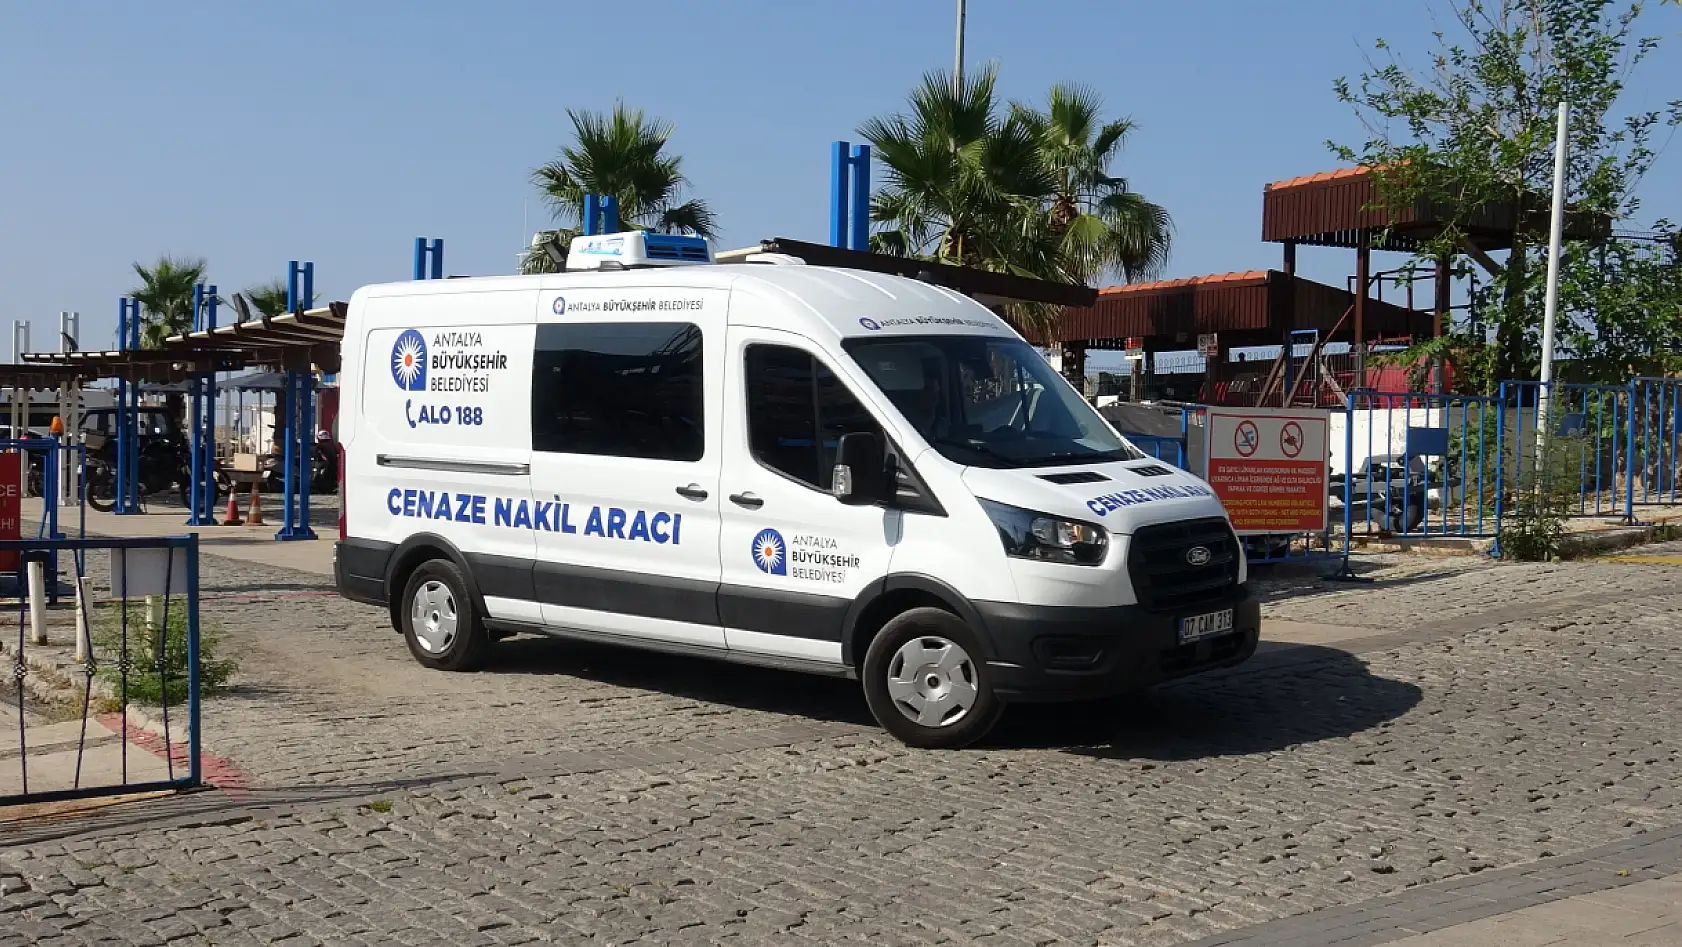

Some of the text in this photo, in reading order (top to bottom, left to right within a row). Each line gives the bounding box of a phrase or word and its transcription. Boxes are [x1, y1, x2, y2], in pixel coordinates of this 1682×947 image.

[567, 297, 704, 313] ANTALYA BÜYÜKŞEHİR BELEDİYESİ
[430, 332, 508, 392] ANTALYA BÜYÜKŞEHİR BELEDİYESİ
[418, 404, 483, 426] ALO 188
[386, 487, 682, 545] CENAZE NAKİL ARACI
[1086, 488, 1153, 517] CENAZE
[1139, 484, 1191, 501] NAKİL
[791, 534, 860, 584] ANTALYA BÜYÜKŞEHİR BELEDİYESİ
[1184, 618, 1195, 636] 07
[1216, 610, 1232, 629] 313
